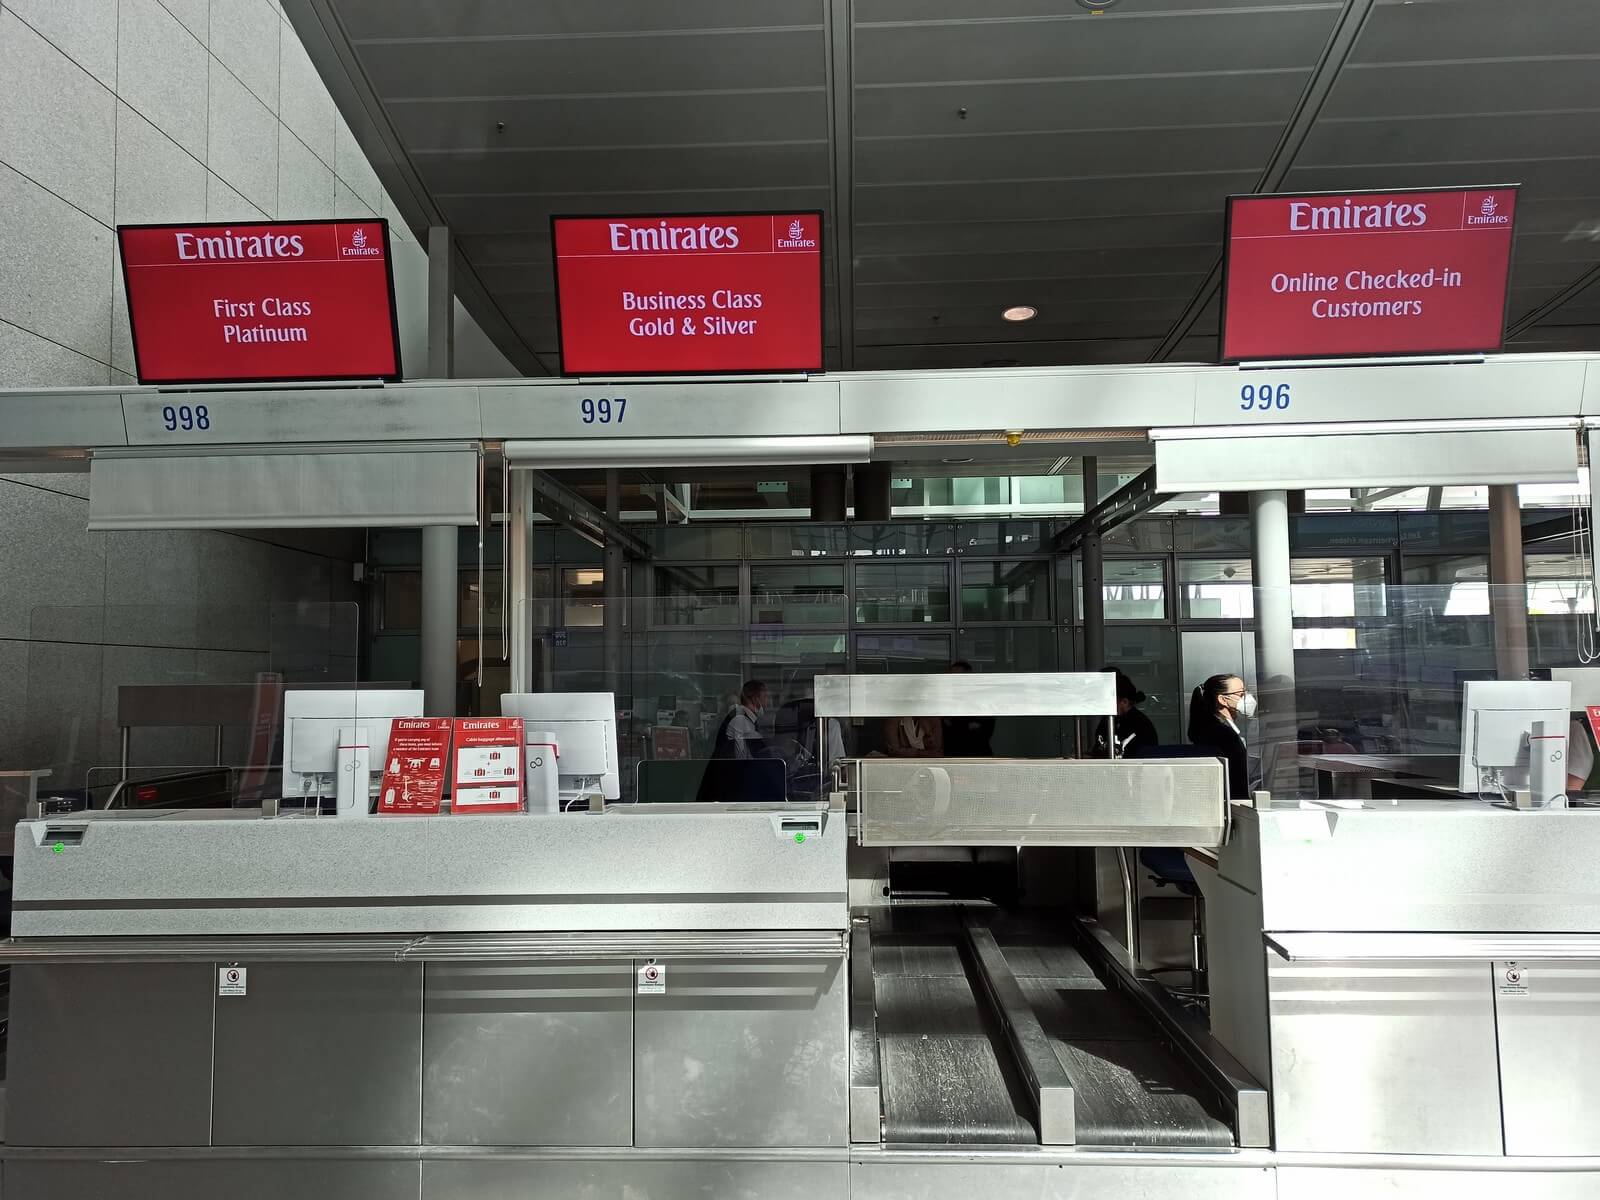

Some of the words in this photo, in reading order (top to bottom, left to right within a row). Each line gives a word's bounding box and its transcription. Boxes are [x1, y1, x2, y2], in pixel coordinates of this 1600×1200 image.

[1290, 199, 1427, 232] Emirates
[1467, 213, 1509, 225] Emirates
[175, 230, 305, 261] Emirates
[608, 220, 739, 251] Emirates
[777, 236, 816, 249] Emirates
[341, 244, 380, 256] Emirates
[1271, 272, 1339, 293] Online
[1345, 267, 1462, 290] Checked-in
[213, 299, 255, 318] First
[261, 297, 312, 317] Class
[622, 291, 705, 310] Business
[712, 290, 763, 309] Class
[1311, 298, 1422, 319] Customers
[223, 324, 308, 343] Platinum
[629, 317, 675, 337] Gold
[681, 317, 696, 336] &
[703, 316, 757, 336] Silver
[1240, 384, 1291, 411] 996
[162, 405, 209, 431] 998
[581, 398, 627, 424] 997
[398, 720, 430, 729] Emirates
[462, 721, 500, 730] Emirates
